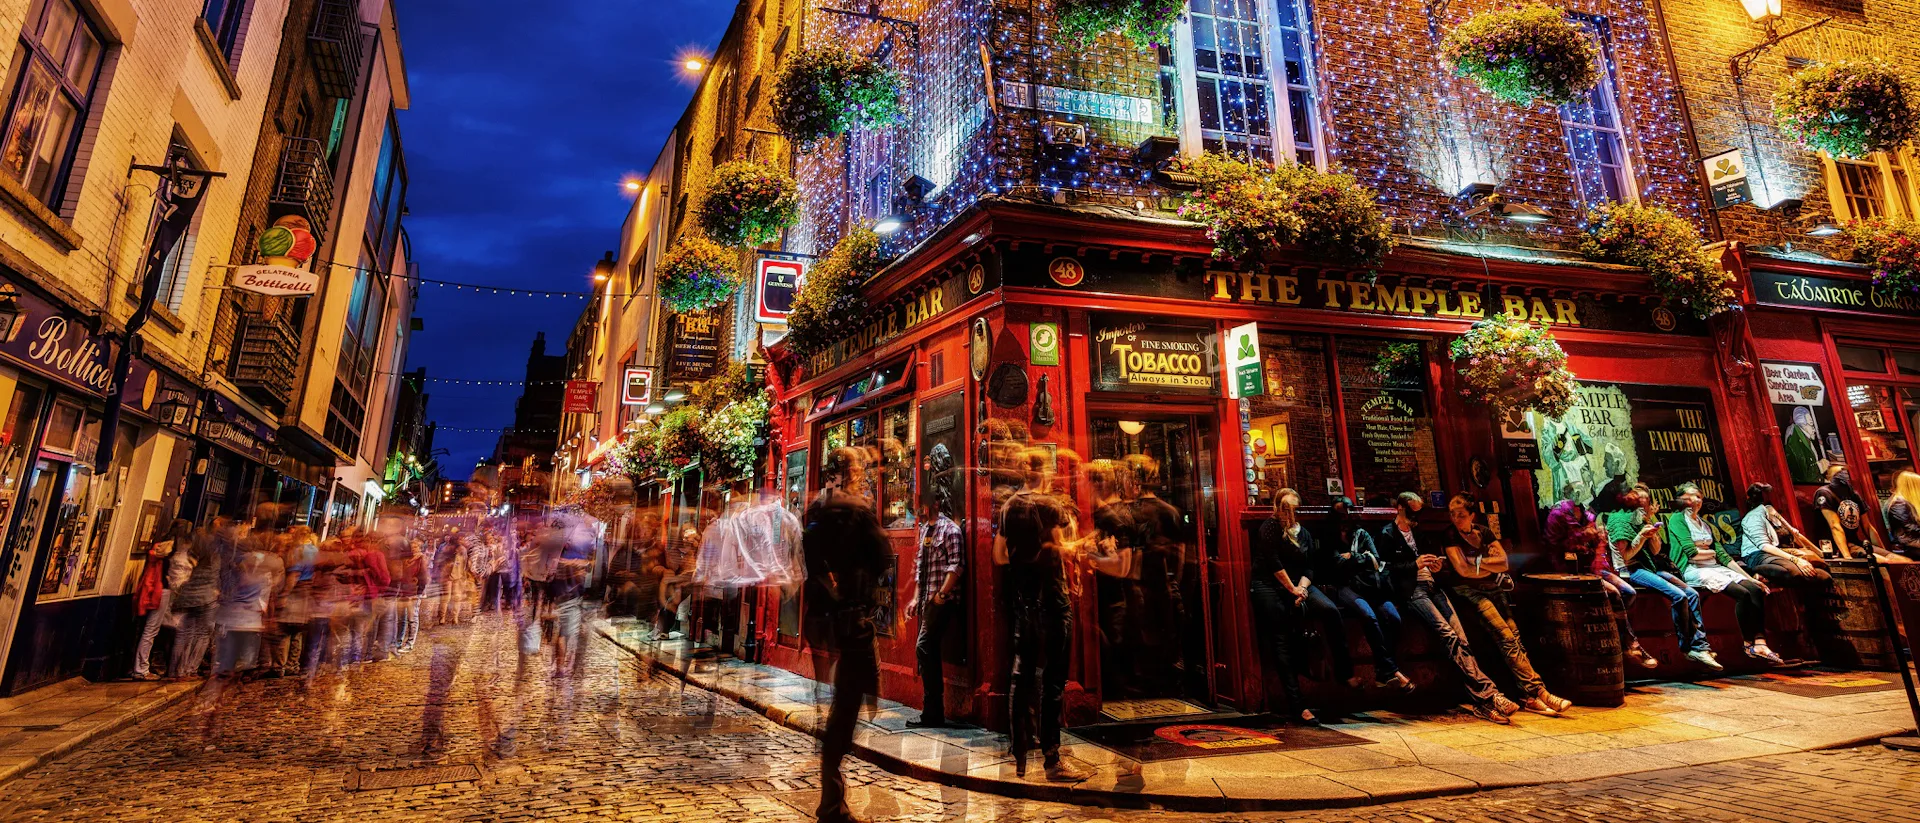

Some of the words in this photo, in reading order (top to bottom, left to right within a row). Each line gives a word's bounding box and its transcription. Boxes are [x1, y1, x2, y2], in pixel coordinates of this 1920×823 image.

[1073, 103, 1096, 114] LANE
[1100, 106, 1130, 117] SOUTH
[1140, 105, 1149, 117] 2
[256, 269, 300, 279] GELATERIA
[970, 269, 982, 289] 48
[1054, 261, 1077, 279] 48
[242, 274, 313, 292] Botticelli
[767, 281, 794, 289] GUINNESS
[1206, 270, 1302, 304] THE
[1318, 279, 1486, 319] TEMPLE
[1502, 294, 1581, 327] BAR
[677, 314, 720, 327] TEMPLE
[685, 317, 711, 334] BAR
[811, 343, 836, 377] THE
[840, 311, 898, 362] TEMPLE
[905, 286, 944, 329] BAR
[1096, 321, 1147, 345] Importers
[1127, 334, 1138, 342] OF
[1141, 339, 1161, 350] FINE
[1161, 340, 1200, 352] SMOKING
[1110, 343, 1202, 379] TOBACCO
[1130, 373, 1166, 384] Always
[1170, 375, 1180, 384] in
[1182, 375, 1211, 386] Stock
[1764, 366, 1782, 378] Beer
[1782, 367, 1811, 380] Garden
[1768, 378, 1800, 394] Smoking
[1361, 395, 1394, 413] TEMPLE
[1398, 398, 1414, 416] BAR
[1777, 391, 1796, 403] Area
[1579, 408, 1616, 428] BAR
[1676, 408, 1706, 430] THE
[1647, 430, 1712, 453] EMPEROR
[1698, 456, 1714, 477] OF
